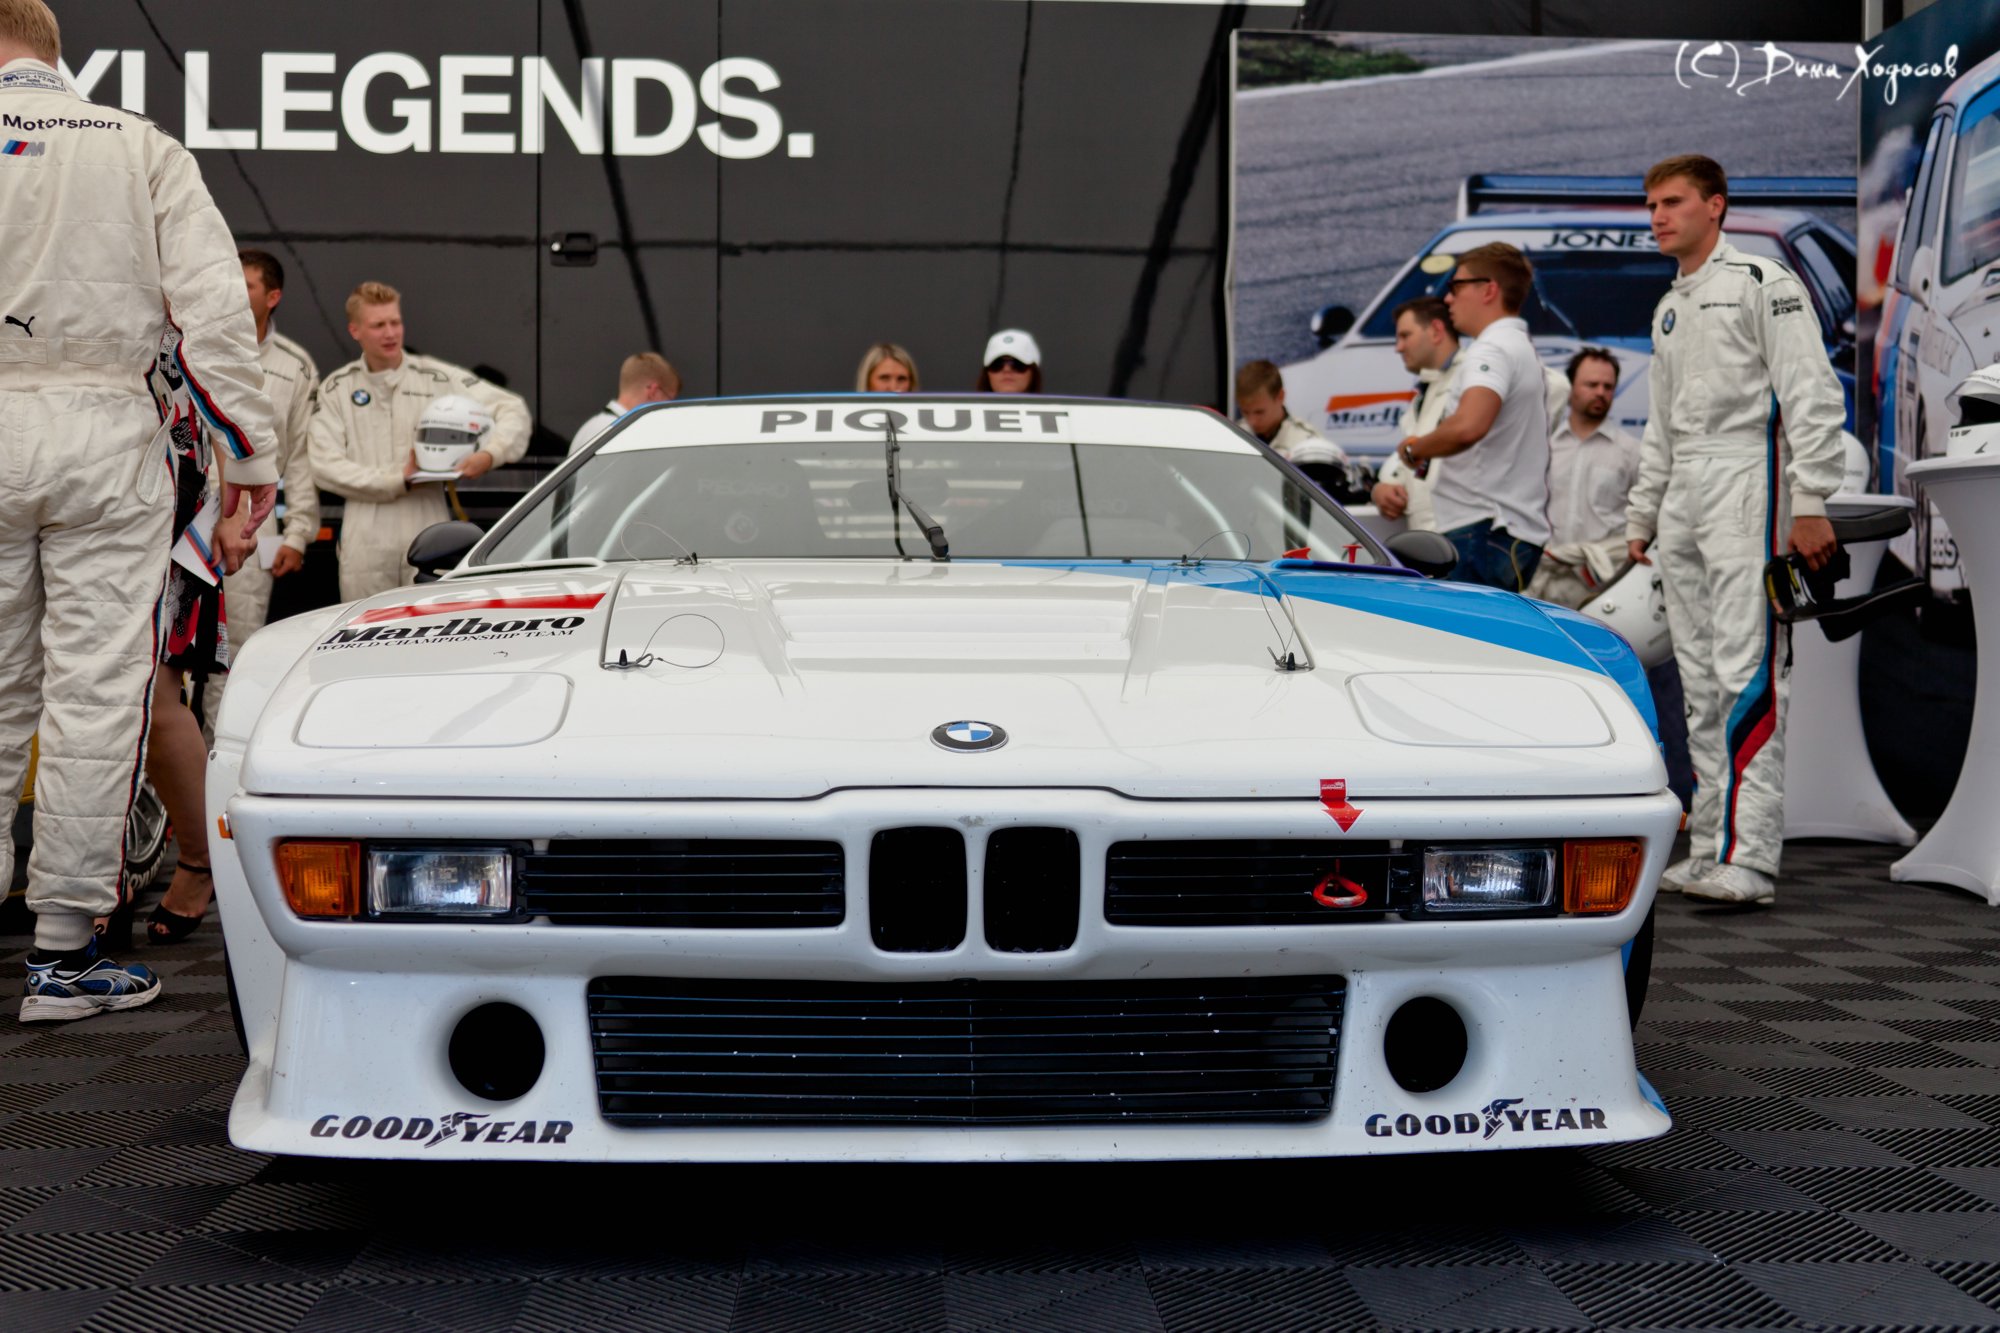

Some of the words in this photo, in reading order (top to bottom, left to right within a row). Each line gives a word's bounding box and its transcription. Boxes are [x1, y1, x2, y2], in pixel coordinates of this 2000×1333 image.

[185, 51, 815, 160] LEGENDS.
[2, 113, 124, 132] Motorsport
[760, 408, 1069, 435] PIQUET
[316, 640, 381, 651] WORLD
[385, 631, 516, 648] CHAMPIONSHIP
[525, 629, 575, 639] TEAM
[321, 616, 585, 646] Marlboro
